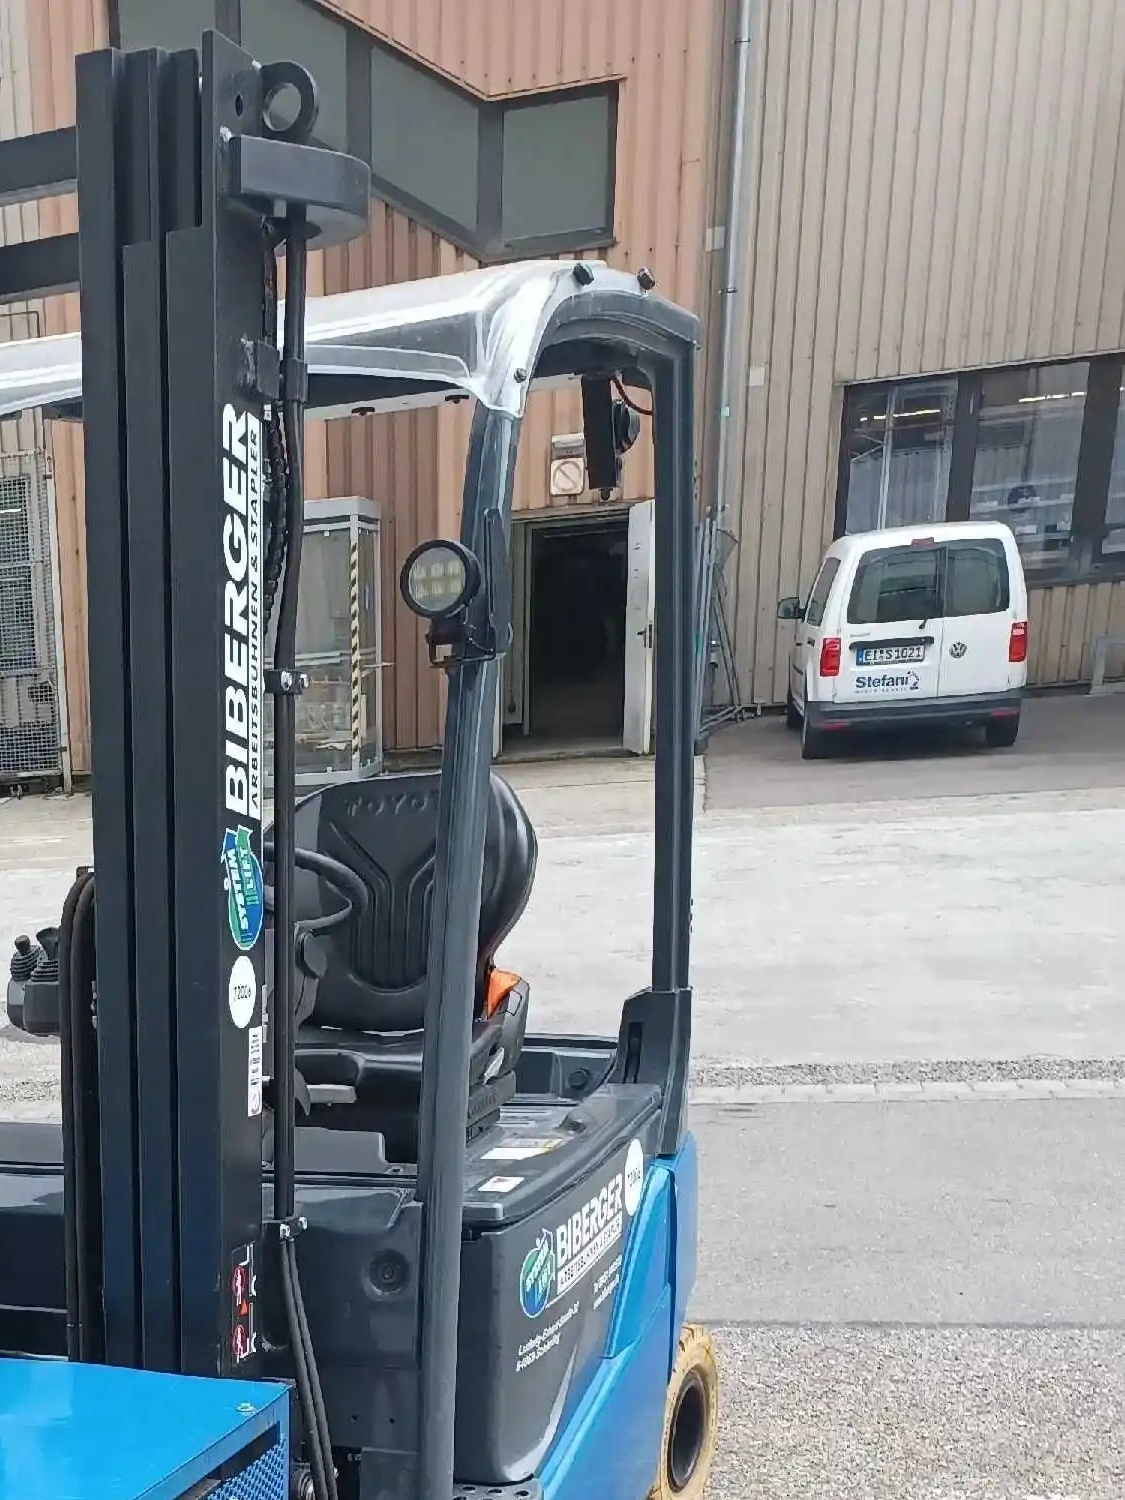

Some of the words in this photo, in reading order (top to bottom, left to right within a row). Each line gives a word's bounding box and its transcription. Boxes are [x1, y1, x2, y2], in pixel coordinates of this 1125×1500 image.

[250, 430, 259, 546] STAPLER
[250, 555, 258, 573] &
[223, 403, 248, 816] BIBERGER
[855, 674, 908, 689] Stefani
[226, 848, 249, 931] SYSTEM
[555, 1173, 623, 1269] BIBERGER
